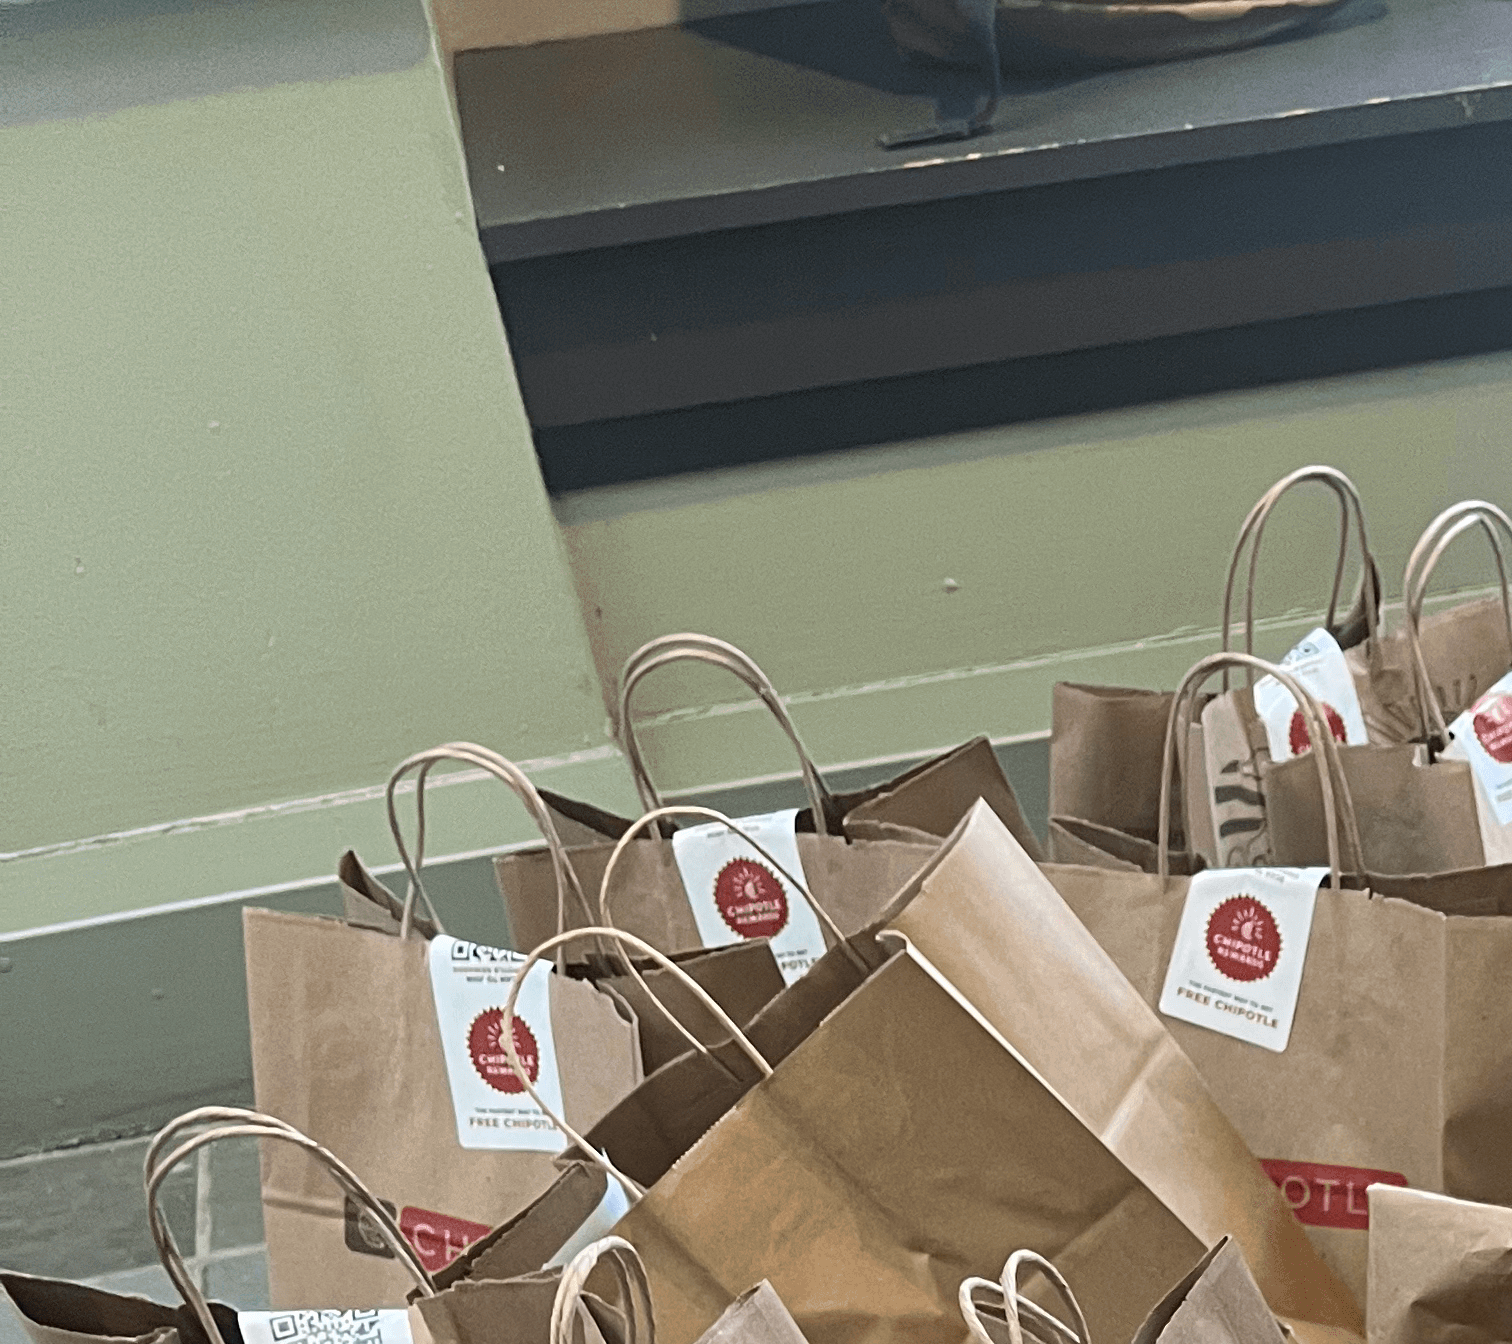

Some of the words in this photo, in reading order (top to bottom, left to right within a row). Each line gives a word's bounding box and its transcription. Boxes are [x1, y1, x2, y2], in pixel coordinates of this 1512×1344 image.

[1213, 933, 1271, 962] CHIPOTLE
[1177, 986, 1211, 1006] FREE
[1214, 999, 1280, 1029] CHIPOTLE
